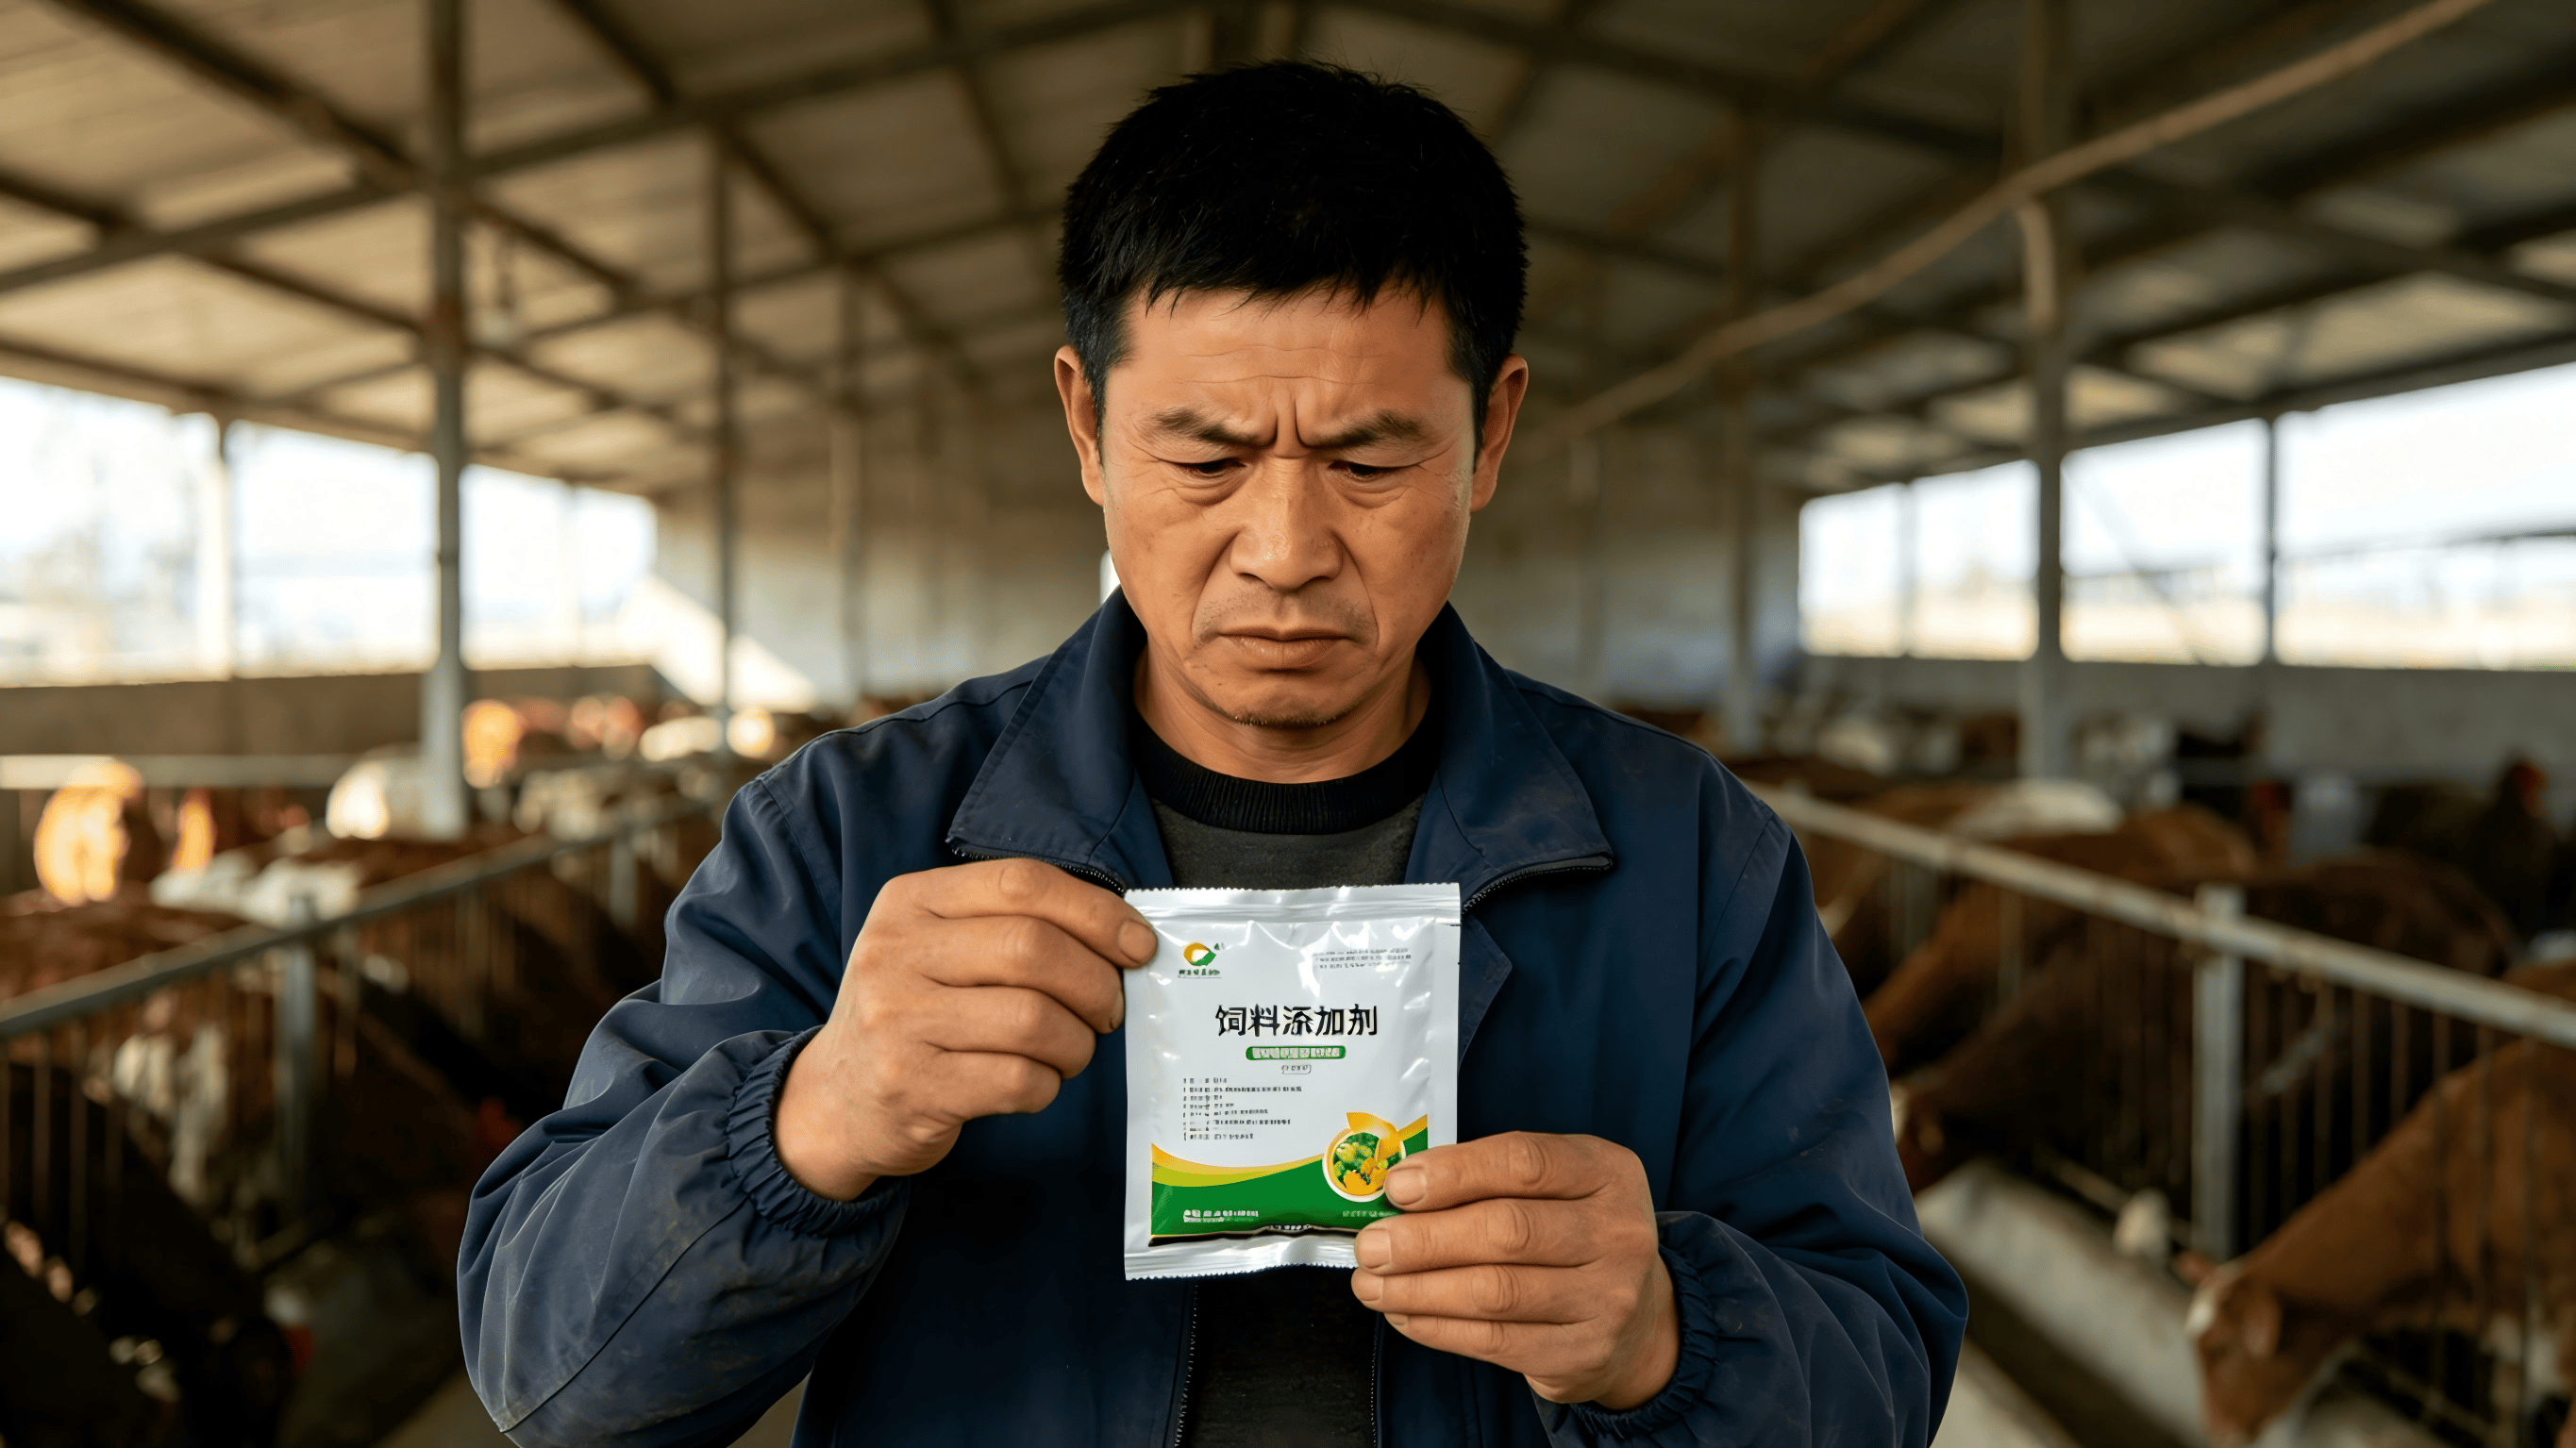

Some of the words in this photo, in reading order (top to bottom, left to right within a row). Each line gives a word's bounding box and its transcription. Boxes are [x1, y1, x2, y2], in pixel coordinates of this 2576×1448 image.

[1215, 1004, 1378, 1037] 饲料添加剂
